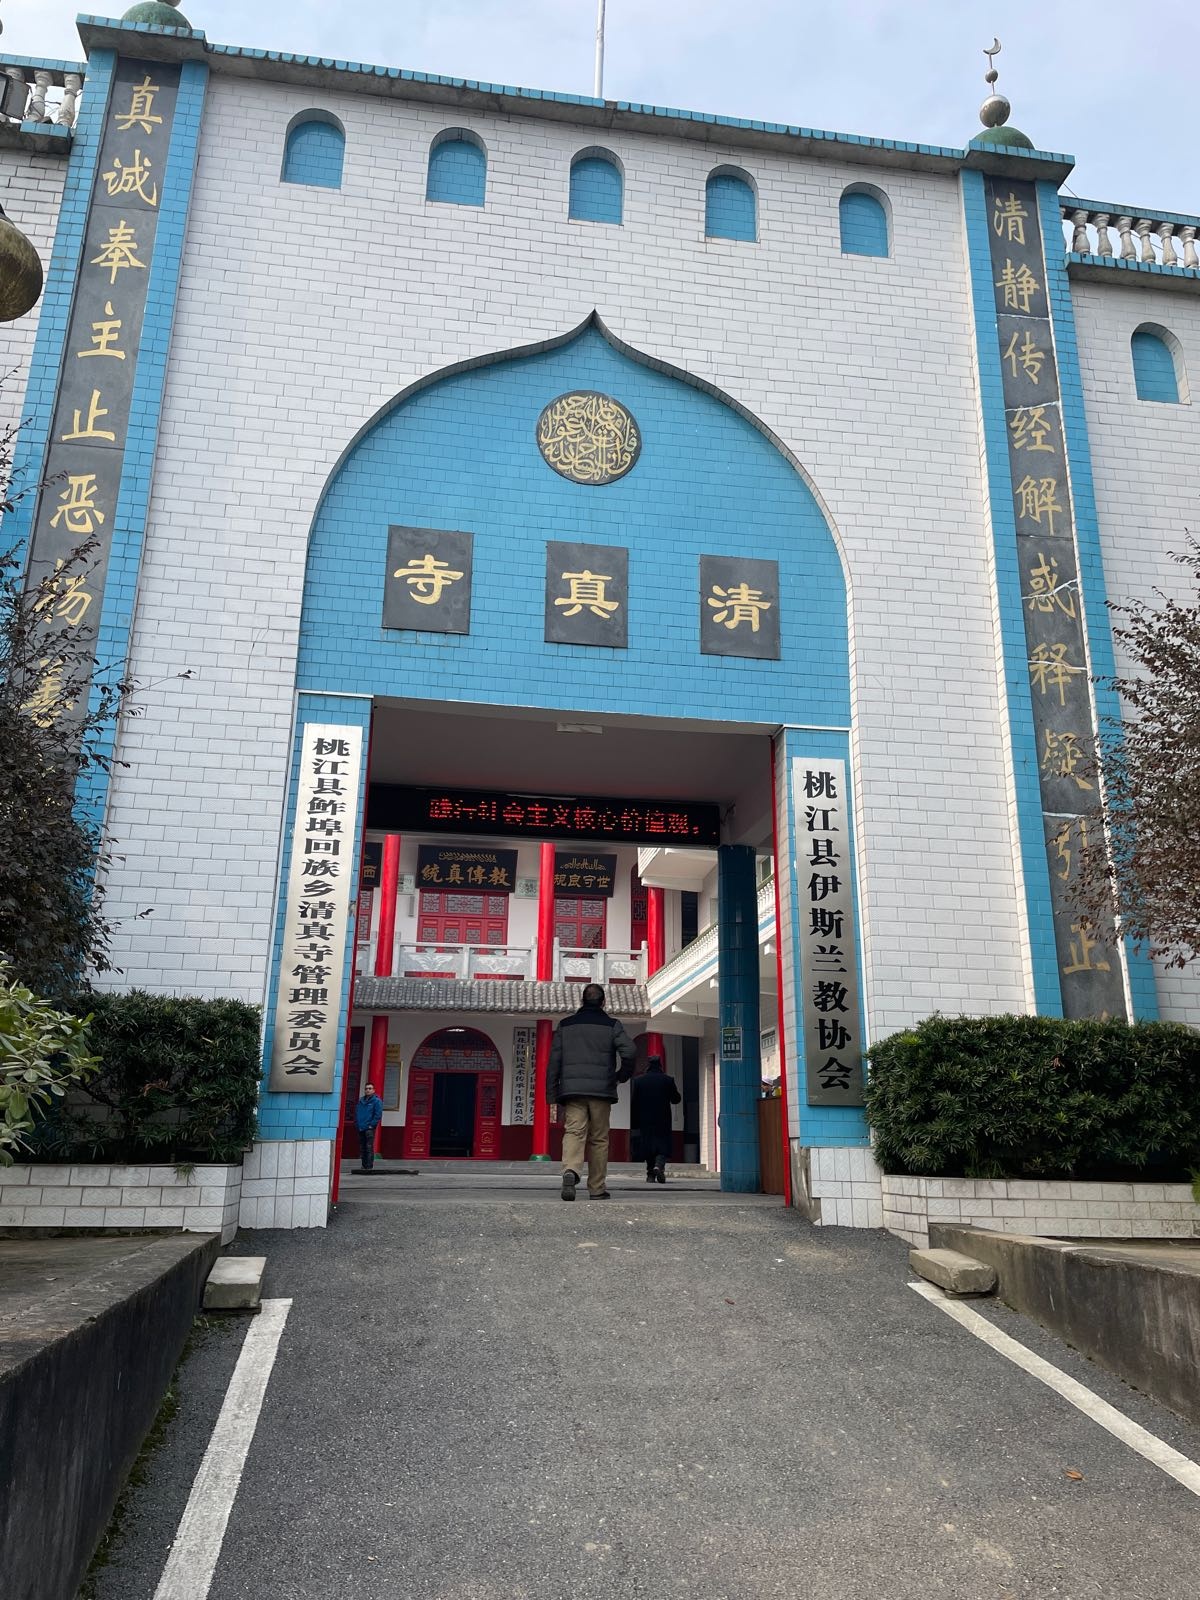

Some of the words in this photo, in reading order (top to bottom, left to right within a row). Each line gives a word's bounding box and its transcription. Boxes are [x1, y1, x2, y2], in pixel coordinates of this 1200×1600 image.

[994, 192, 1112, 1022] 清静传经解惑释疑引正
[282, 737, 350, 1076] 桃江县鲊埠回族乡清真寺管理委员会
[803, 770, 853, 1090] 桃江县伊斯兰教协会
